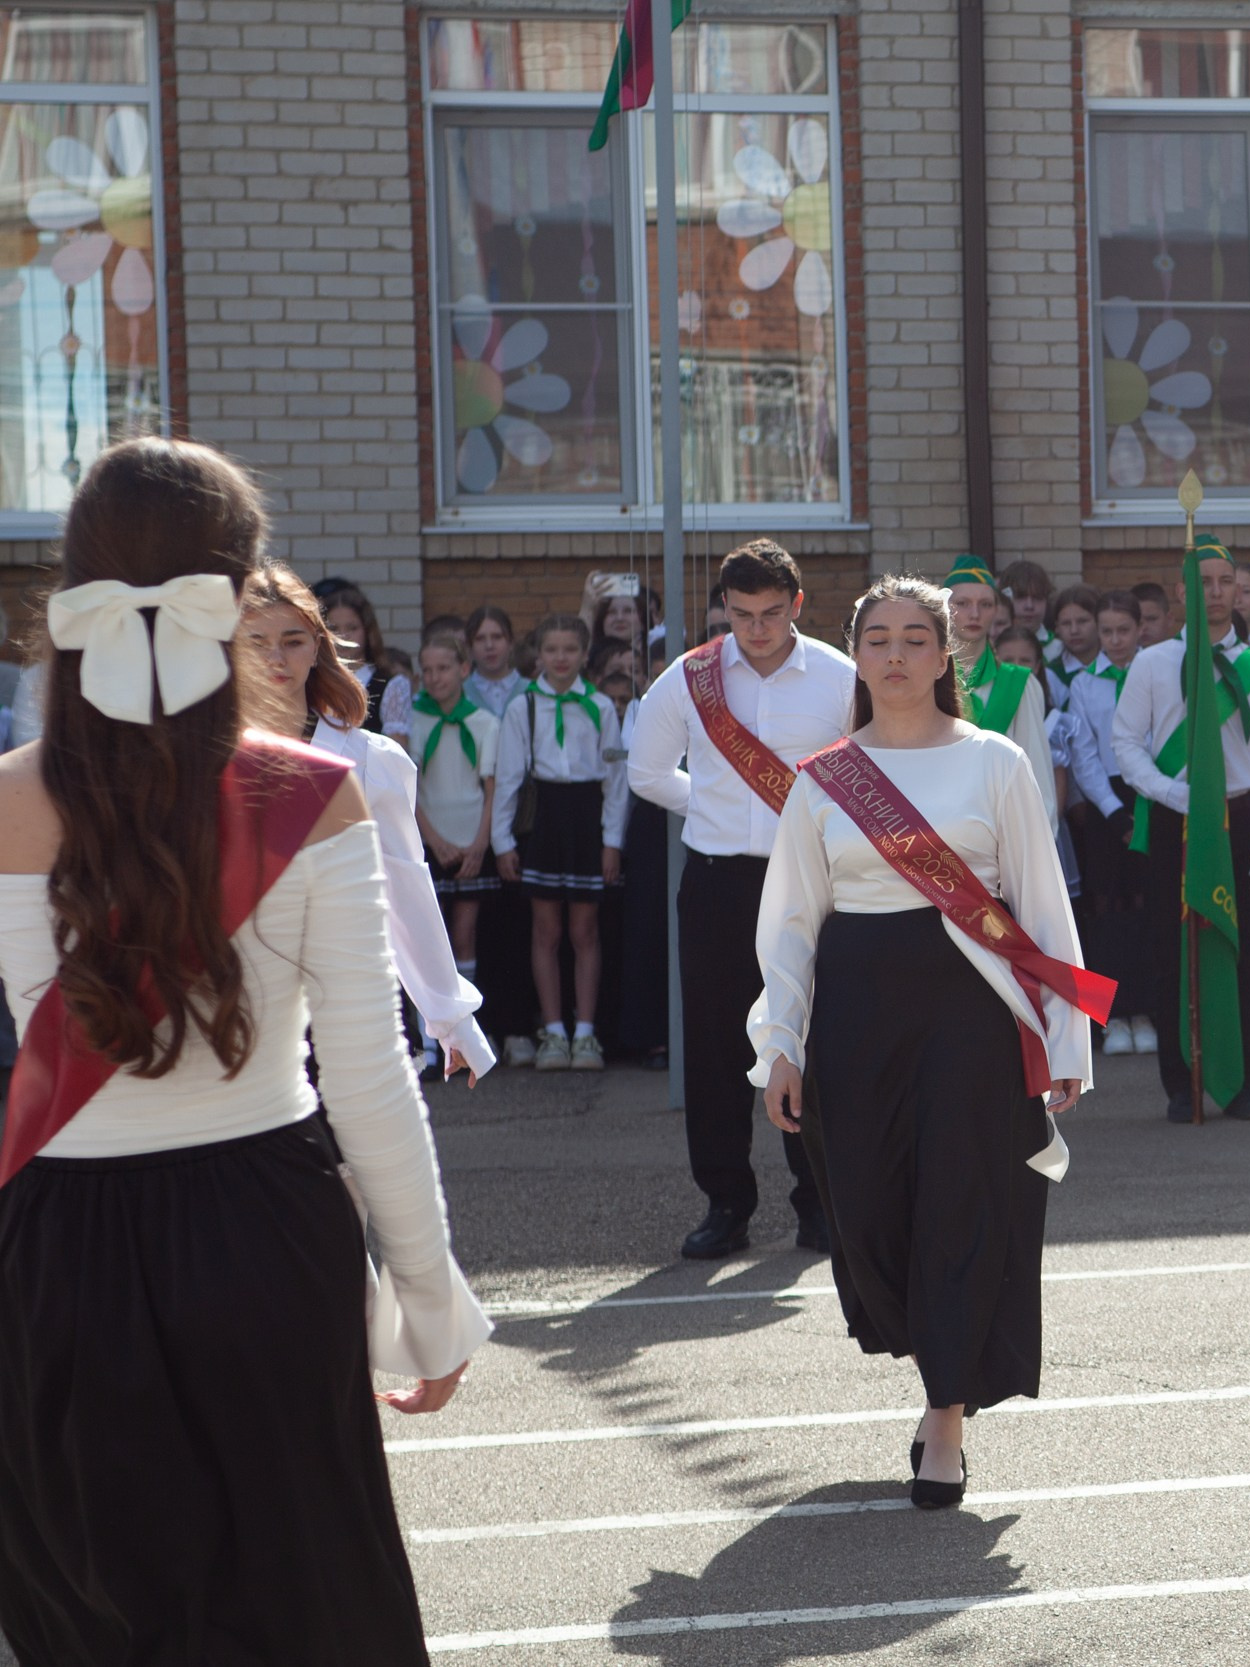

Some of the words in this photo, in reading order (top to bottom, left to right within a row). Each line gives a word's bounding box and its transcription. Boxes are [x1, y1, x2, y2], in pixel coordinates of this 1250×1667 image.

[696, 669, 760, 768] ВЫПУСКНИК
[758, 766, 790, 802] 202
[857, 755, 880, 781] София
[819, 748, 917, 854] ВЫПУСКНИЦА
[912, 849, 961, 893] 2025
[862, 816, 884, 839] СОШ
[879, 835, 899, 858] №10
